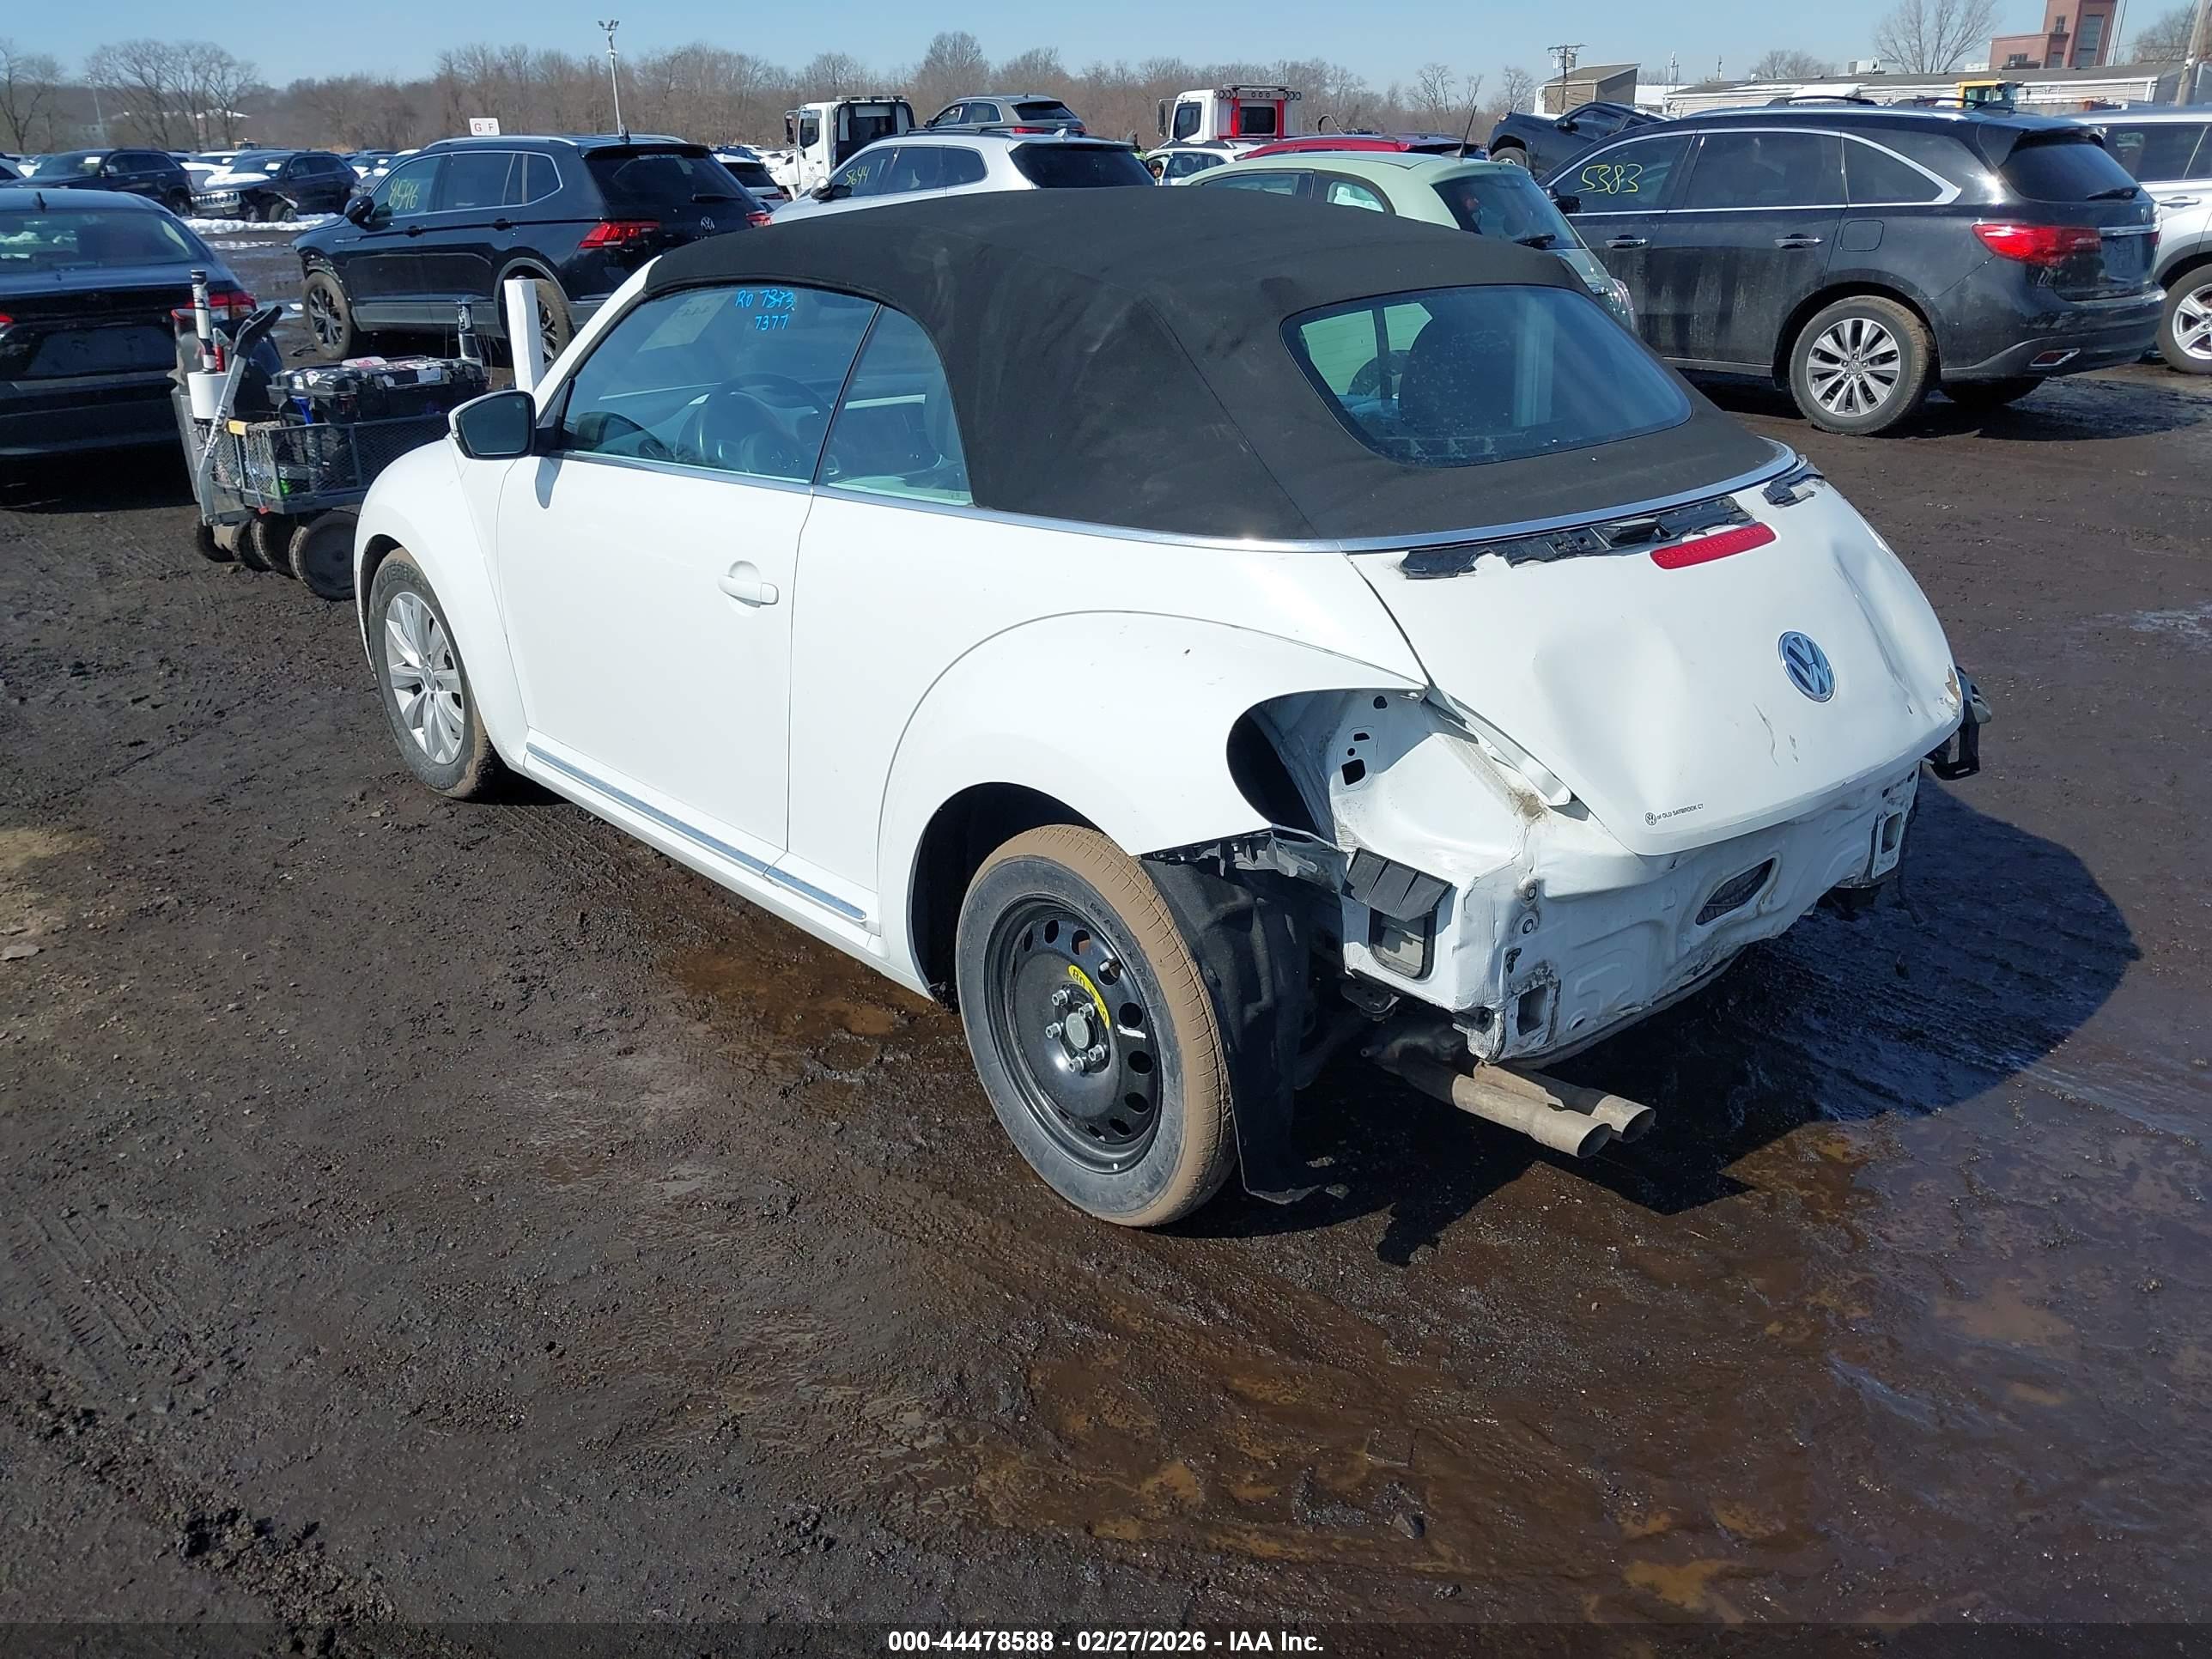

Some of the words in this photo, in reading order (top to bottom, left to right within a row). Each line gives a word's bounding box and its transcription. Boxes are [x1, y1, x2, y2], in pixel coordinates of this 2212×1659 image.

[474, 123, 482, 132] G
[488, 123, 494, 131] F
[843, 165, 871, 186] 5644
[1573, 163, 1643, 195] 5383
[755, 313, 789, 331] 7377
[1778, 630, 1836, 703] VW
